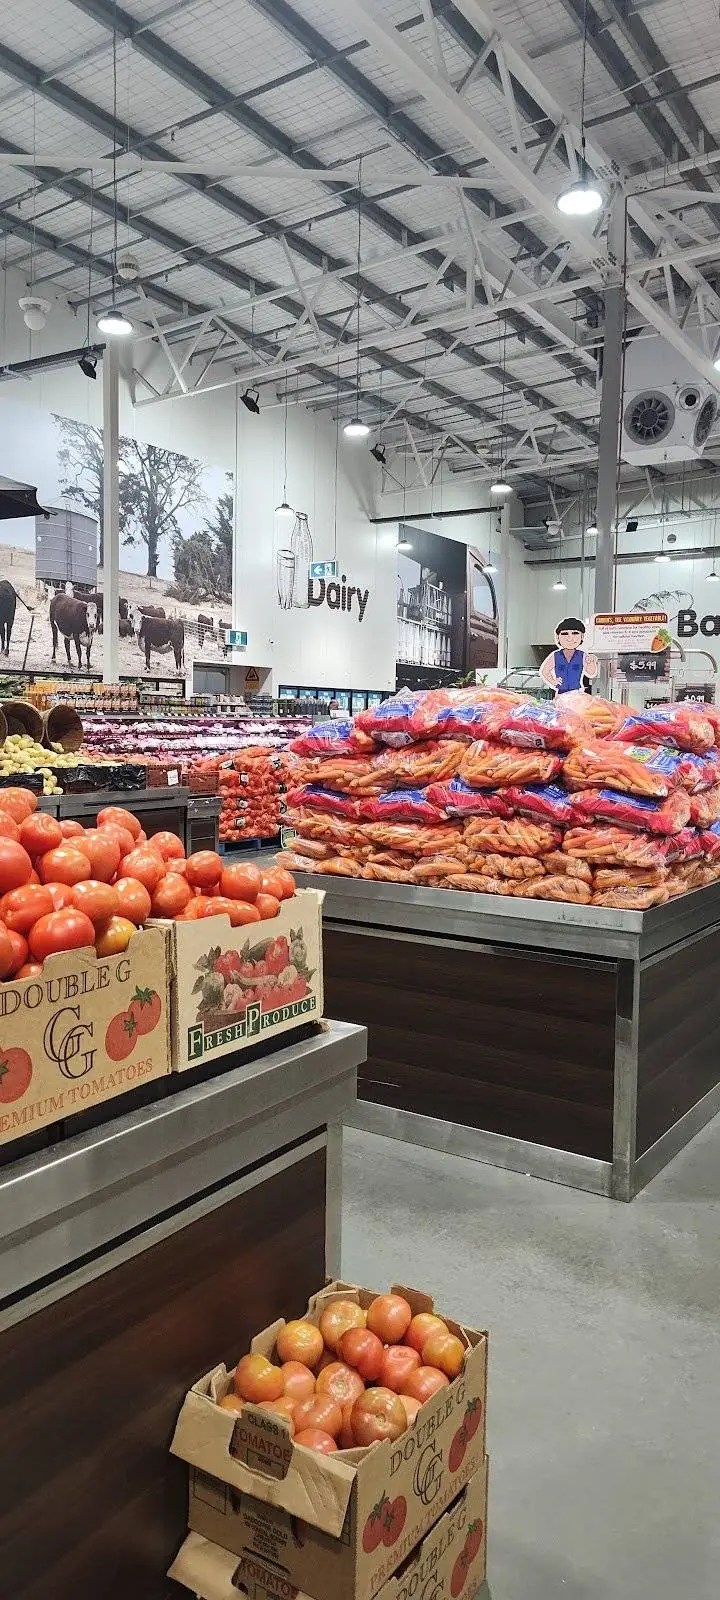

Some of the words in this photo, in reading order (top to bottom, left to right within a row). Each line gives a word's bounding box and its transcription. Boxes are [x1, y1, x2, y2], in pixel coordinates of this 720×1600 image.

[308, 575, 369, 622] Dairy
[678, 609, 720, 637] Ba
[630, 660, 657, 670] $5.99
[0, 965, 110, 1017] DOUBLE
[116, 960, 131, 983] G
[189, 1024, 243, 1057] FRESH
[247, 998, 316, 1034] PRODUCE
[0, 1093, 64, 1132] EMIUM
[68, 1058, 153, 1105] TOMATOES
[233, 1427, 291, 1463] TOMATOE
[248, 1414, 279, 1435] CLASS
[390, 1395, 454, 1477] DOUBLE
[456, 1382, 466, 1404] G
